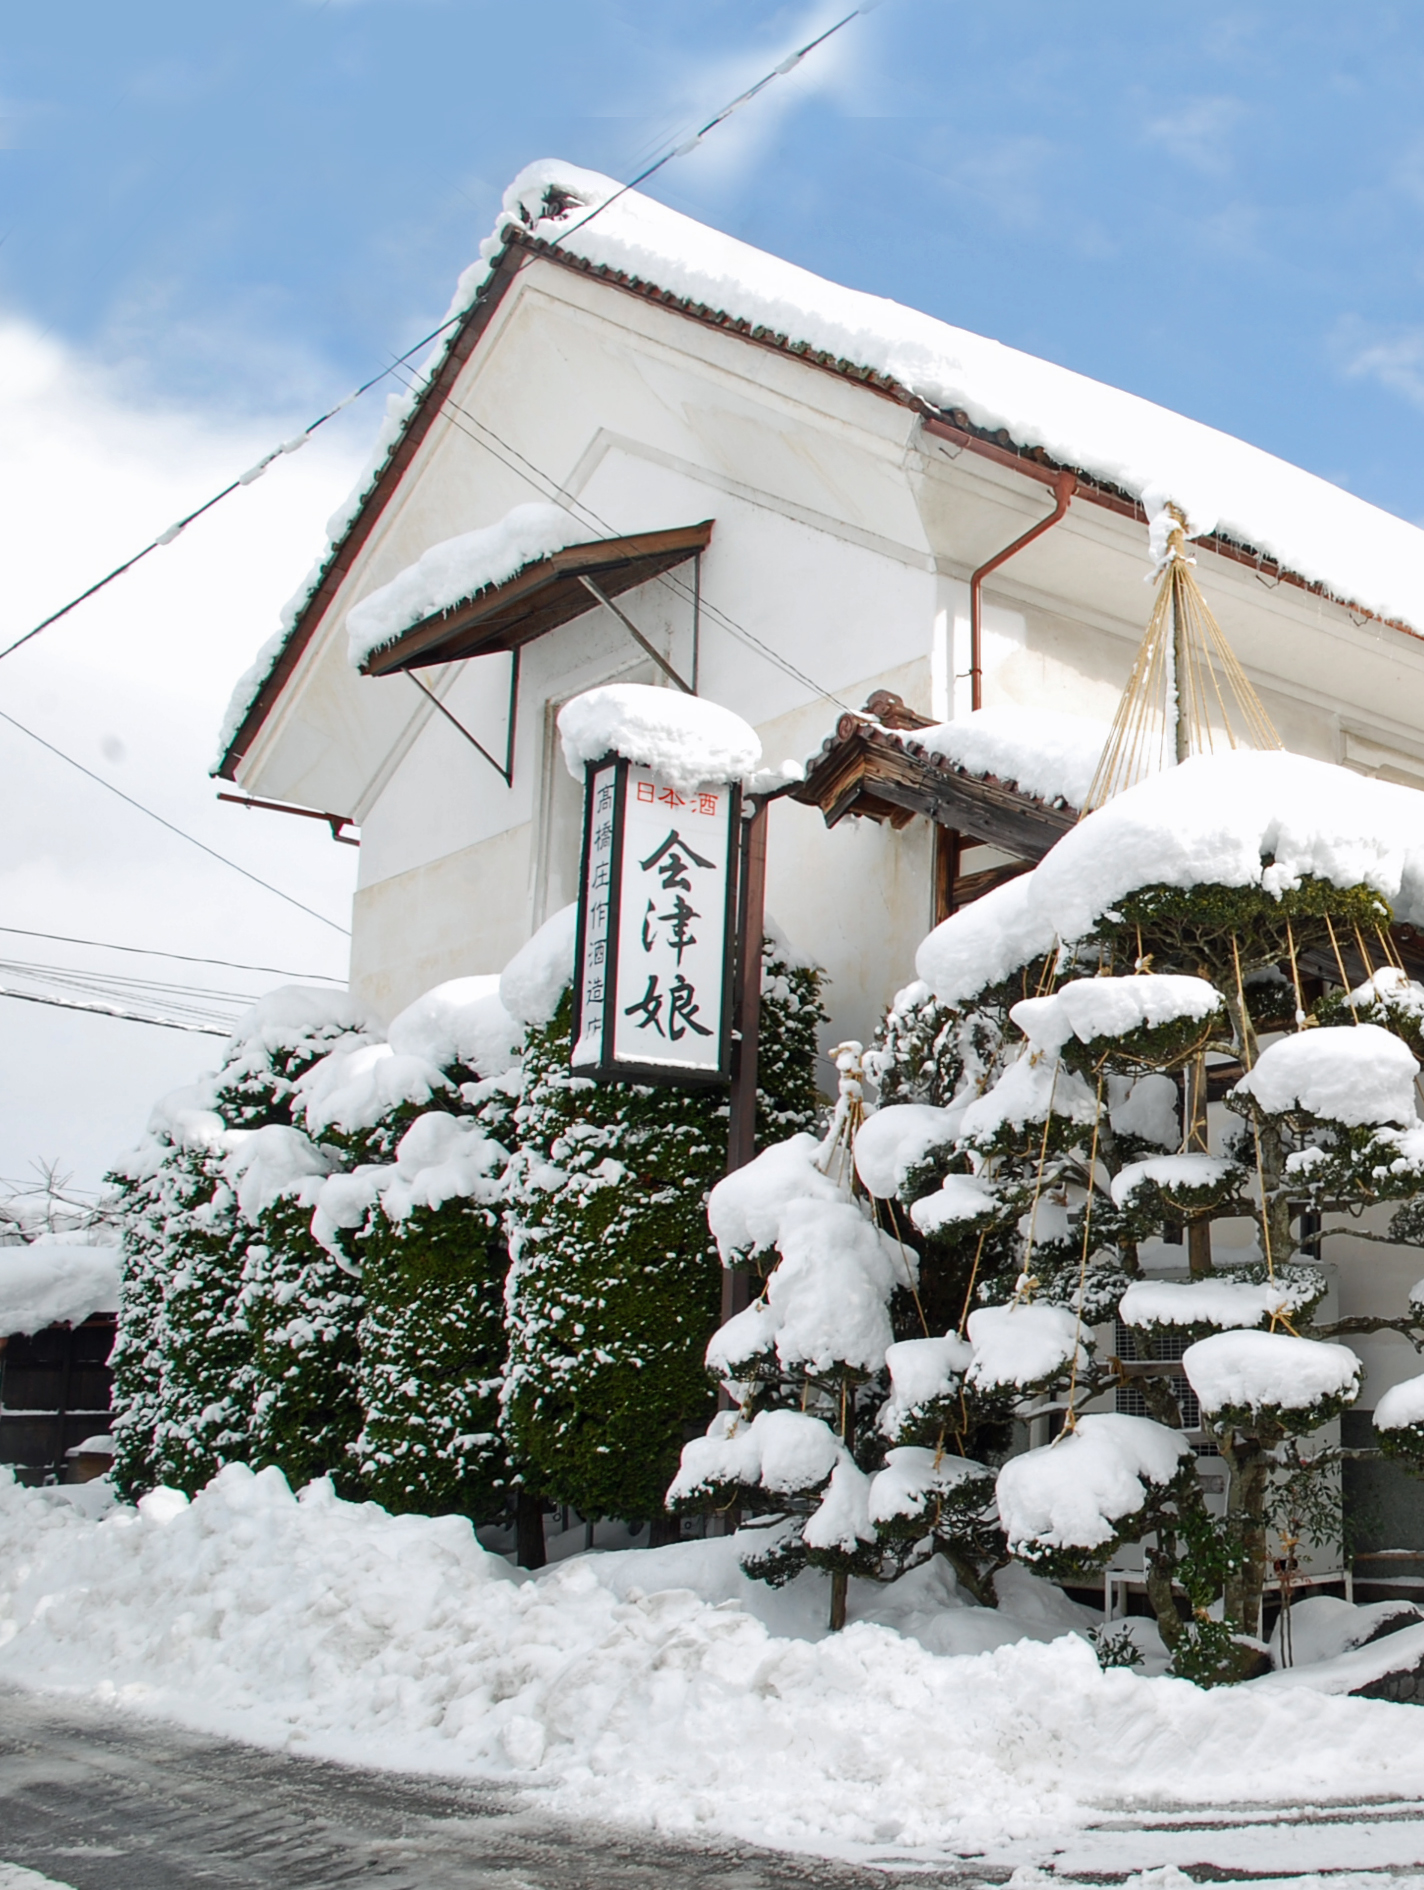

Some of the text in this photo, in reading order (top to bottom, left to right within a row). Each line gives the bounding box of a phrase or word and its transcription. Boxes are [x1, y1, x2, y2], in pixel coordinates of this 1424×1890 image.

[637, 782, 718, 816] 日本酒
[625, 829, 717, 1042] 会津娘
